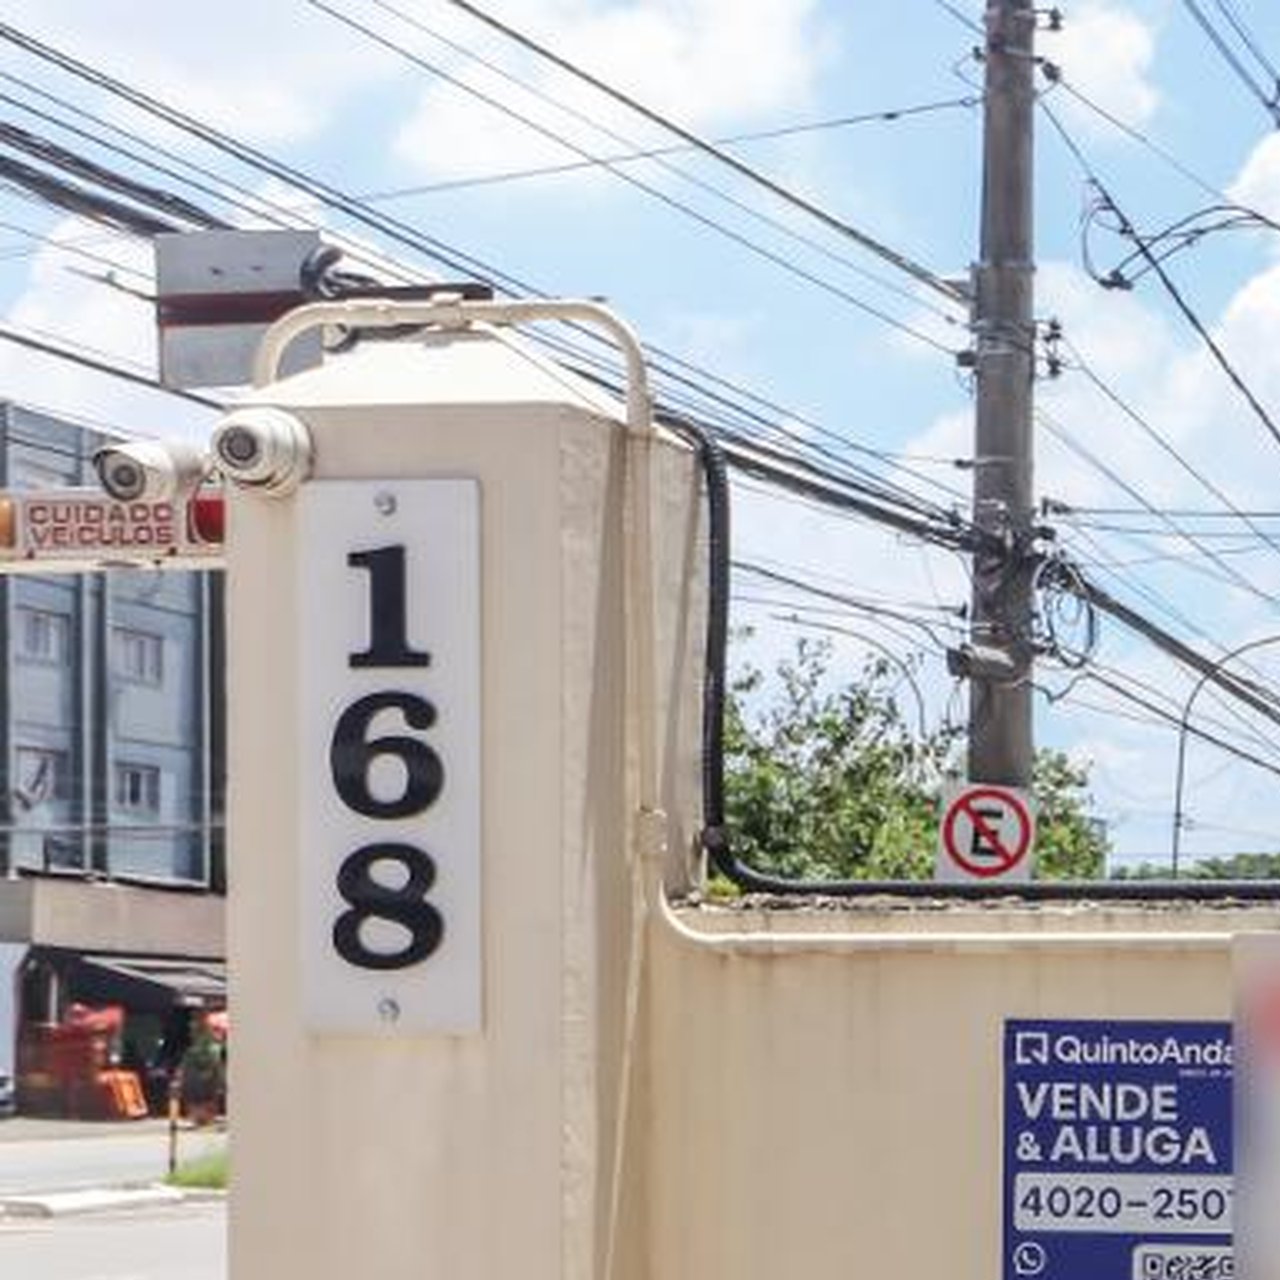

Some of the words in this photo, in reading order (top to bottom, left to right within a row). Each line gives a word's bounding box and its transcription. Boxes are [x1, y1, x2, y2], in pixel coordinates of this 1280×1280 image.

[29, 503, 173, 525] CUIDADO
[330, 544, 445, 970] 168
[1055, 1034, 1233, 1066] QuintoAnda
[1016, 1082, 1178, 1121] VENDE
[1015, 1131, 1041, 1162] &
[1050, 1125, 1217, 1164] ALUGA
[1020, 1185, 1233, 1220] 4020-250
